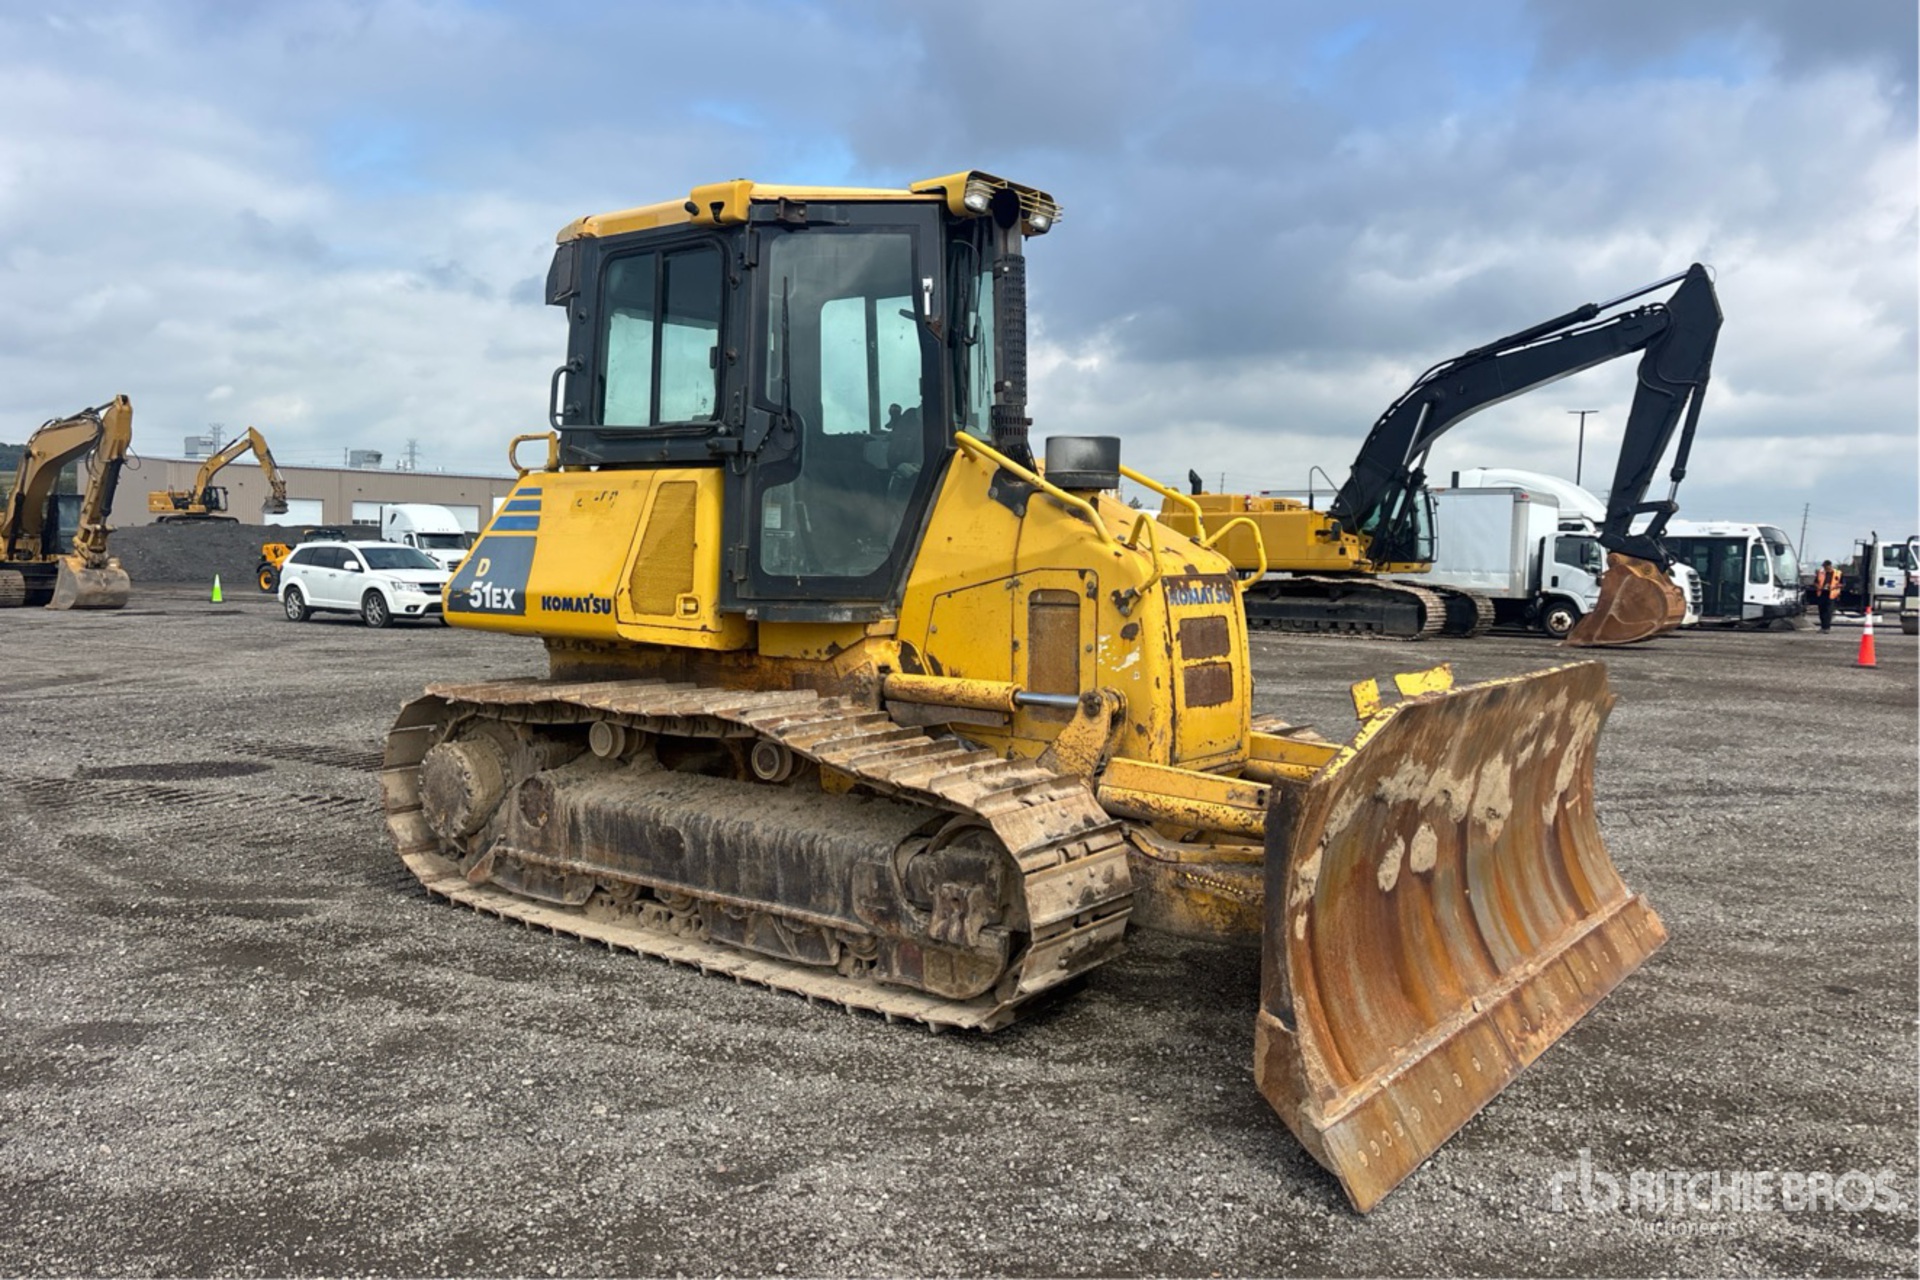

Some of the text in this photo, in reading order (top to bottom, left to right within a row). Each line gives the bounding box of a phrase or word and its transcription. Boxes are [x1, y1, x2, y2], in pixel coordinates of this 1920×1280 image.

[476, 558, 491, 577] D
[469, 581, 515, 610] 51EX
[542, 593, 612, 614] KOMATSU
